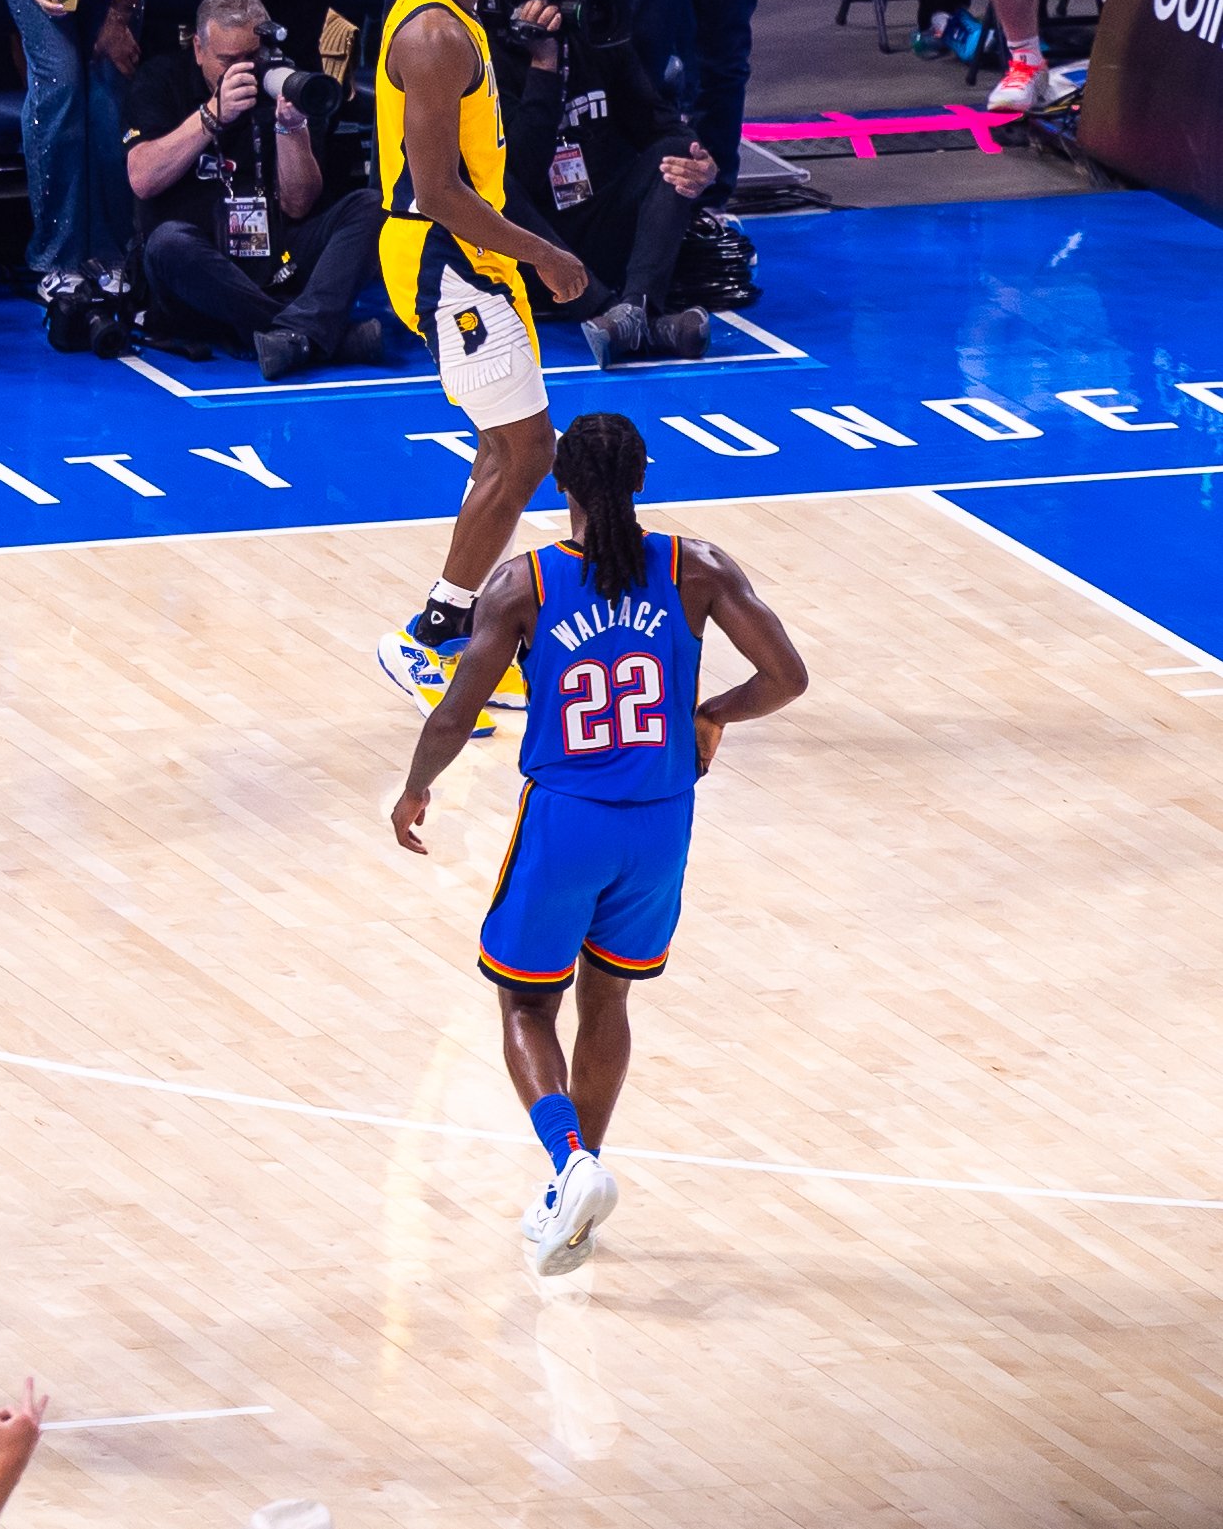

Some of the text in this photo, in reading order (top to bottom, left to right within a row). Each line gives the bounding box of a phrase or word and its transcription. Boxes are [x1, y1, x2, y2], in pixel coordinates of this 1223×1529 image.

[404, 380, 1223, 465] TUNDE
[549, 595, 668, 652] WALLACE
[559, 651, 666, 756] 22
